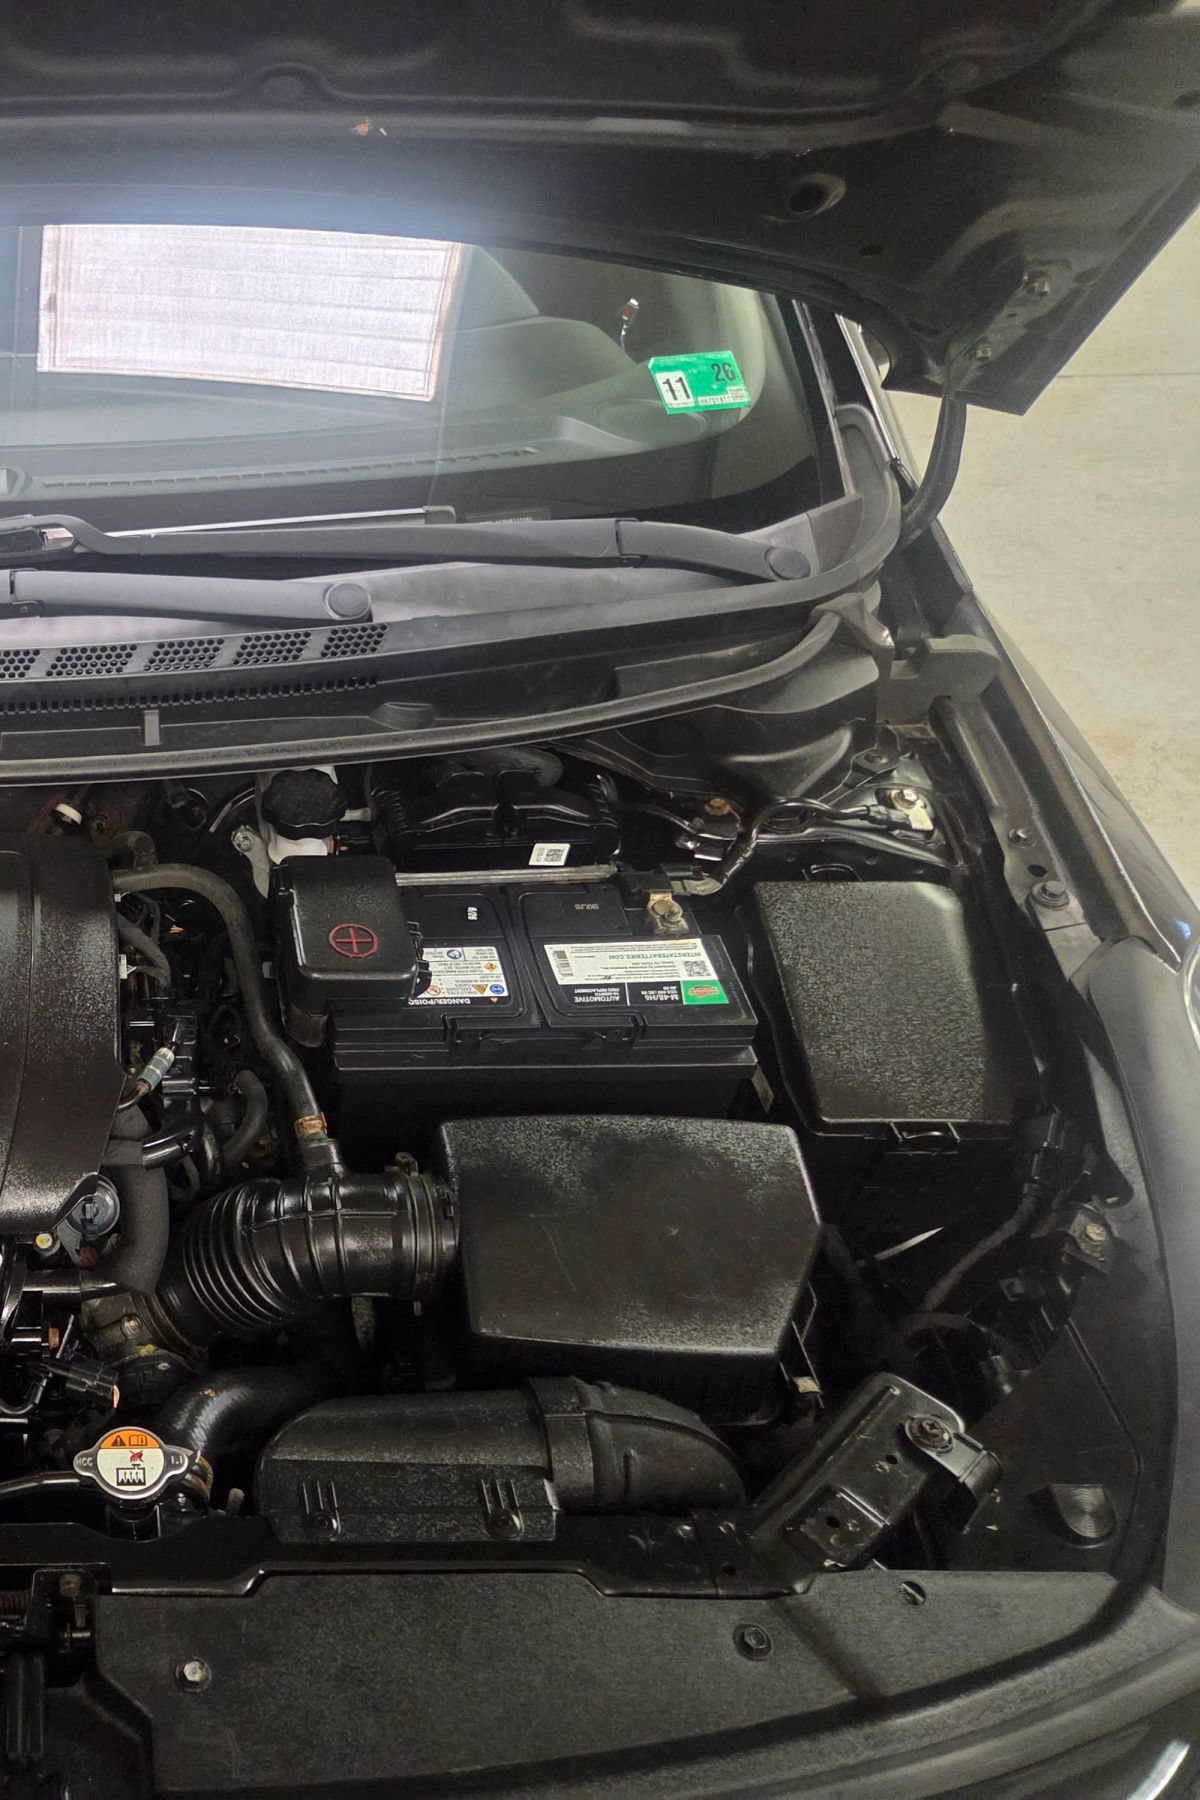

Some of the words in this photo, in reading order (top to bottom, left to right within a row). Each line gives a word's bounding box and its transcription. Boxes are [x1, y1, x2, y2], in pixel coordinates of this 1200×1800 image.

[710, 362, 737, 382] 26
[662, 376, 691, 401] 11
[574, 995, 620, 1003] AUTOMOTIVE
